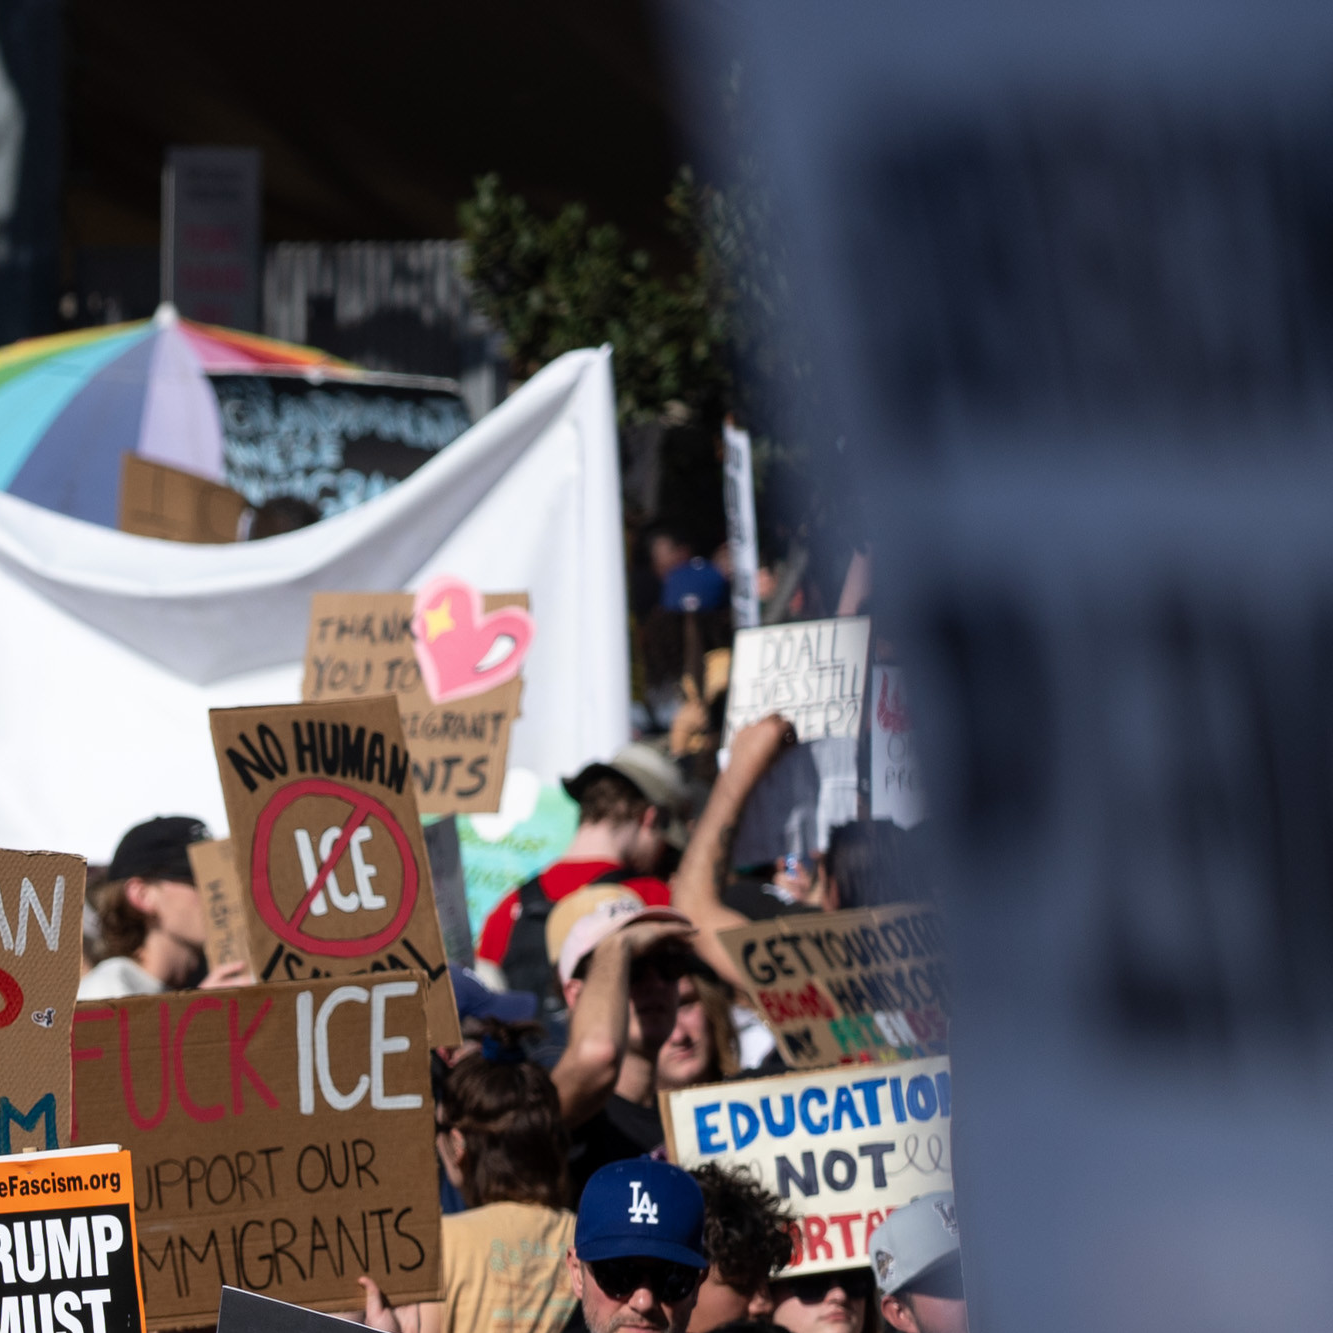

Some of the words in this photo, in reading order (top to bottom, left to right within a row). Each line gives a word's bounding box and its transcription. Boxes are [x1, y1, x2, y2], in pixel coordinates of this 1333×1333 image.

[316, 614, 415, 644] THANK
[760, 632, 792, 672] DO
[795, 623, 846, 671] ALL
[311, 656, 372, 696] YOU
[383, 658, 421, 695] TO
[800, 663, 860, 705] STILL
[401, 711, 506, 747] IGRANT
[226, 722, 289, 793] NO
[291, 720, 411, 796] HUMAN
[411, 755, 490, 799] NTS
[293, 825, 388, 918] ICE
[741, 932, 814, 985] GET
[804, 923, 891, 969] YOUR
[70, 997, 280, 1141] FUCK
[296, 981, 424, 1115] ICE
[133, 1146, 283, 1212] UPPORT
[296, 1138, 380, 1194] OUR
[775, 1141, 896, 1199] NOT
[628, 1181, 658, 1225] LA
[137, 1206, 426, 1302] MMIGRANTS
